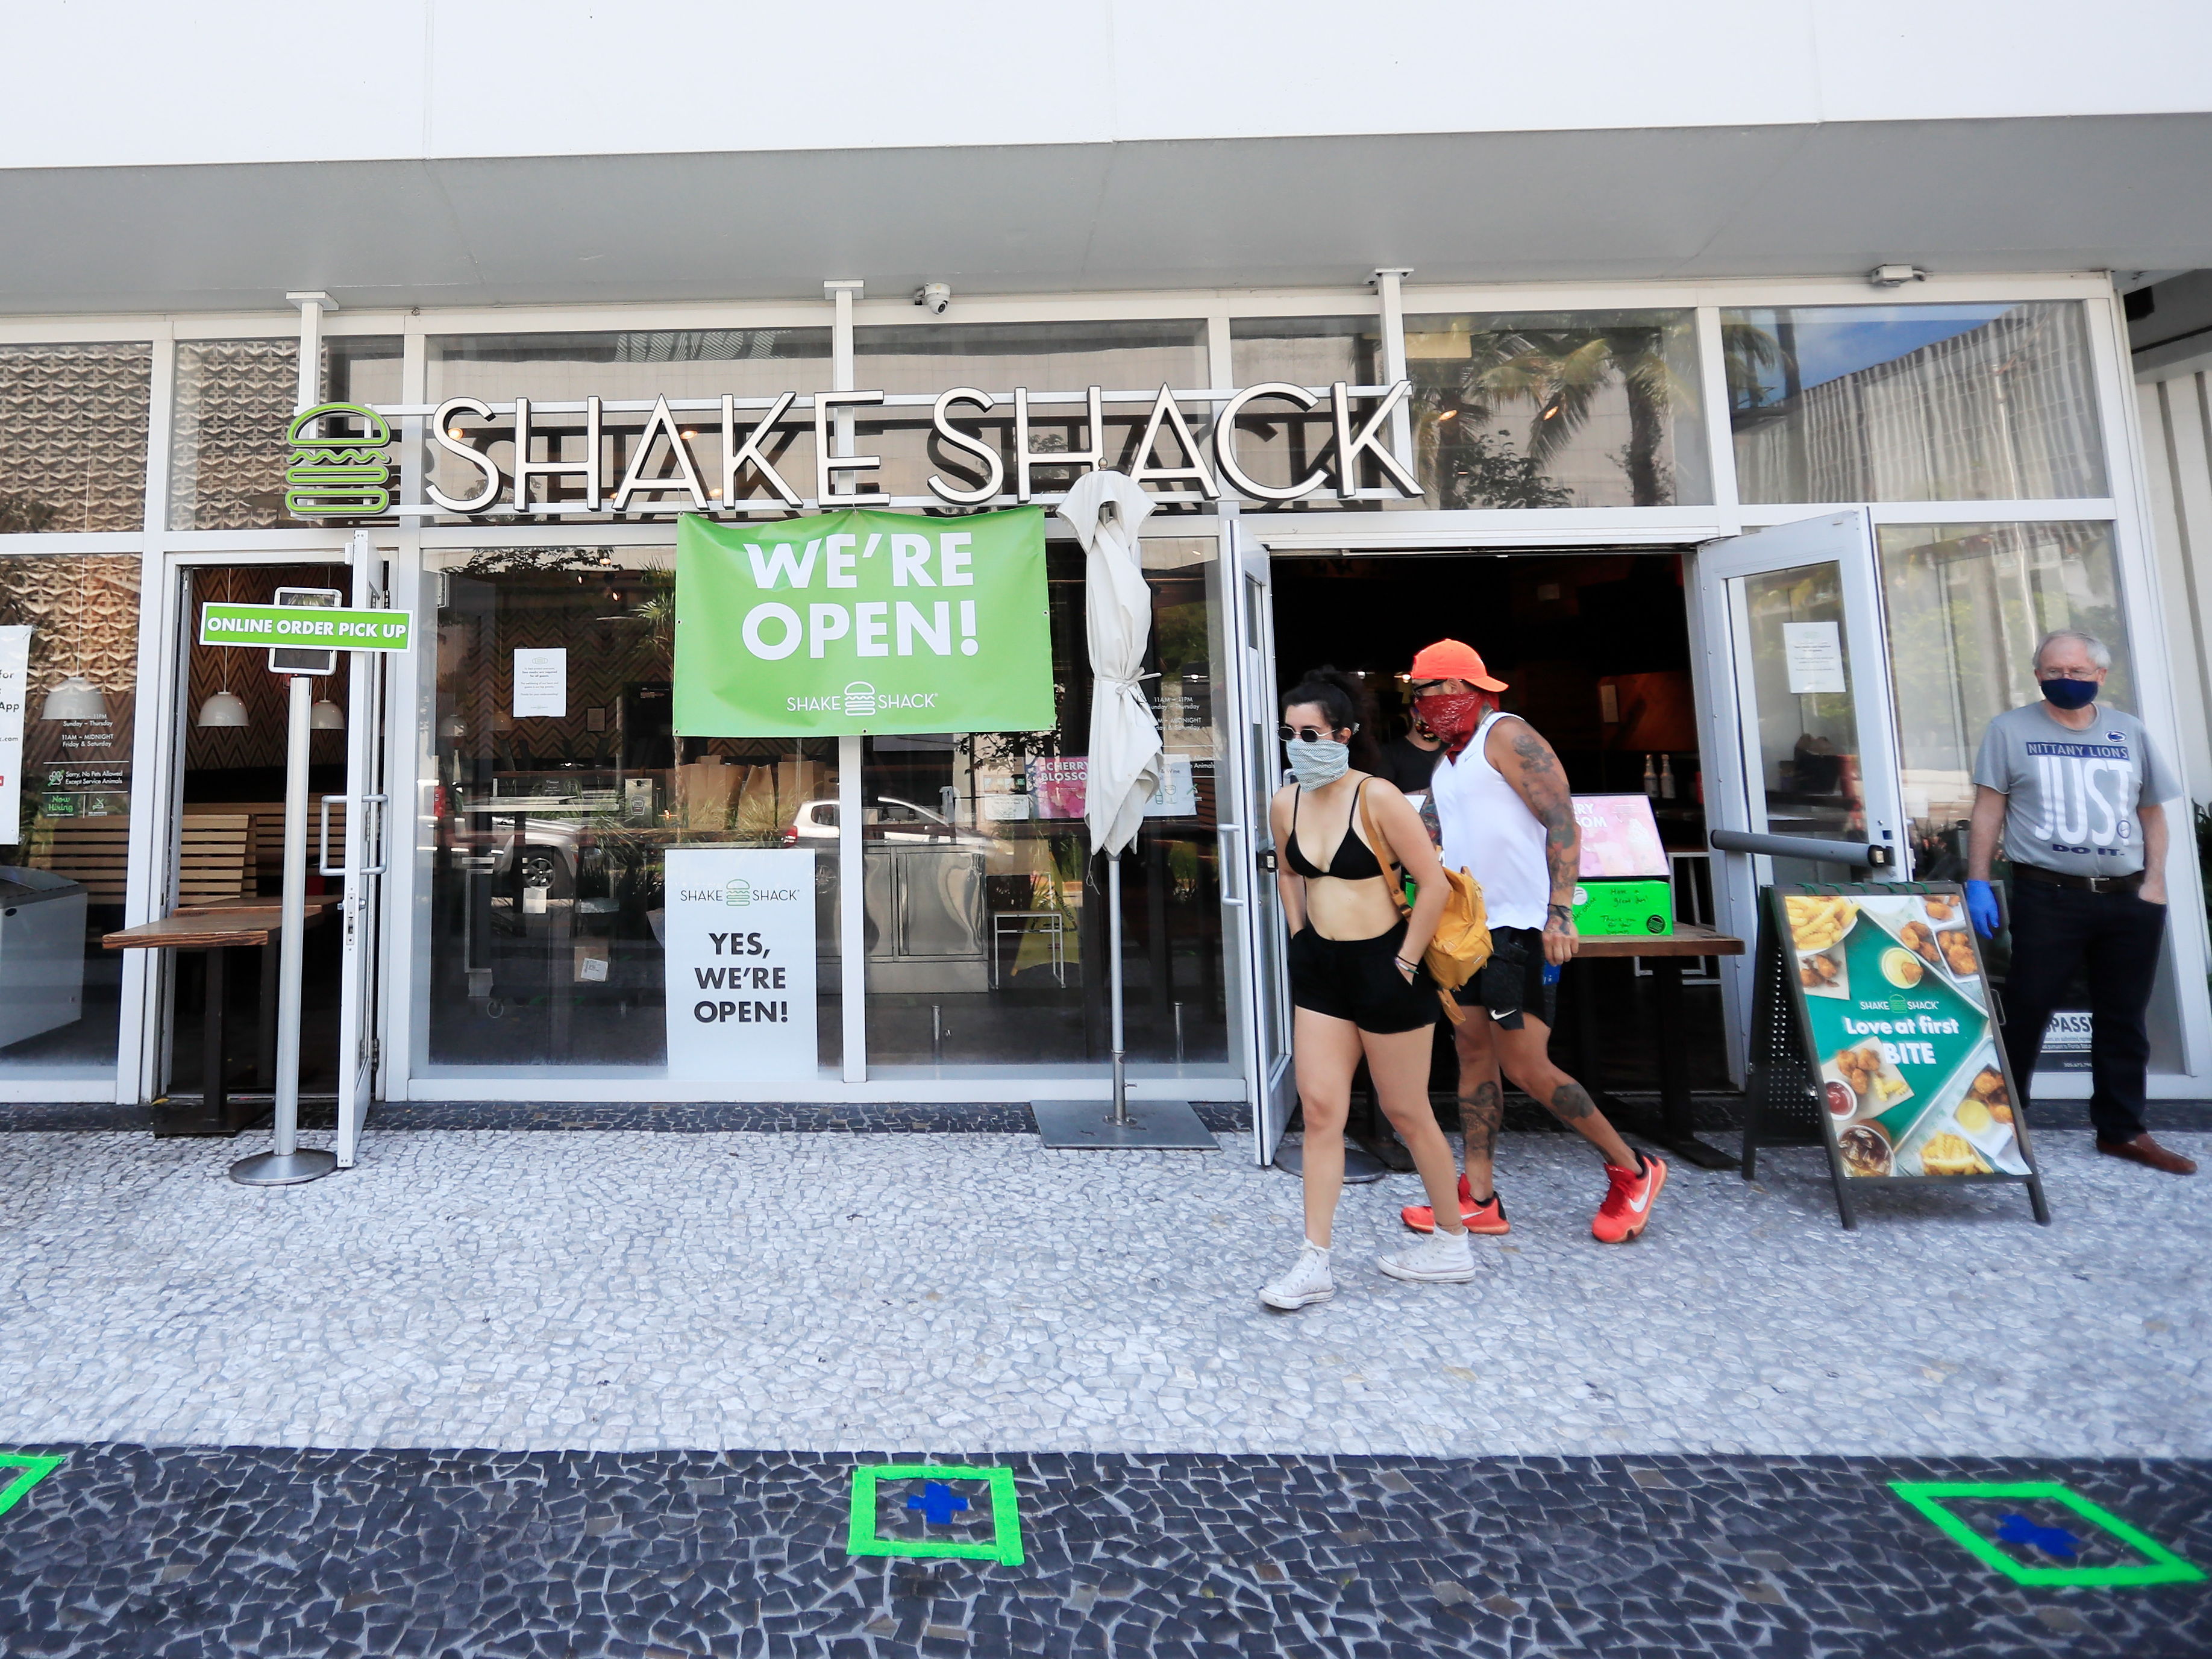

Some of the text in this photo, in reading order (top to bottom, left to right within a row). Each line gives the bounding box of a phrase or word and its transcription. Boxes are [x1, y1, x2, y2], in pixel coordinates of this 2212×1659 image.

[425, 380, 1425, 512] SHAKE SHACK
[743, 532, 974, 589] WE'RE
[207, 616, 407, 638] ONLINE ORDER PICK UP
[742, 600, 979, 661] OPEN!
[786, 693, 936, 712] SHAKE SHACK
[87, 740, 112, 748] Saturday
[2028, 744, 2128, 759] NITTANY LIONS
[1041, 771, 1088, 782] BLOSSO
[48, 803, 74, 813] Hiring
[2035, 757, 2133, 847] JUST
[2052, 844, 2091, 855] DO
[680, 889, 797, 902] SHAKE SHACK
[709, 932, 771, 959] YES,
[694, 967, 786, 989] WE'RE
[694, 1000, 788, 1023] OPEN!
[1860, 1001, 1939, 1010] SHAKE SHACK
[1844, 1015, 1960, 1035] Love at first
[1882, 1043, 1937, 1065] BITE
